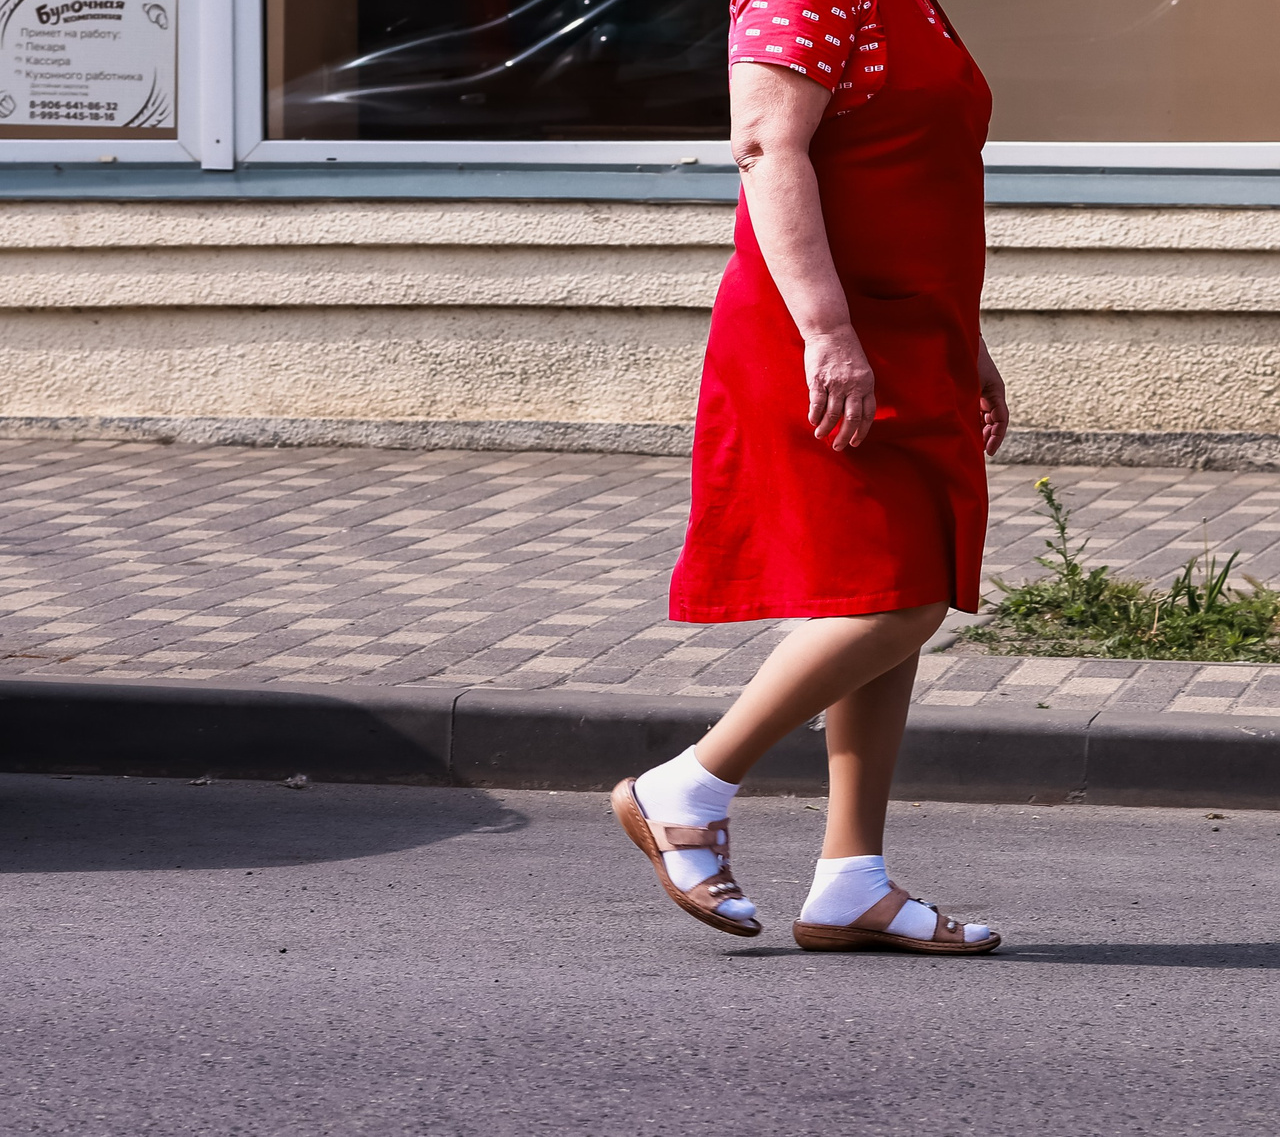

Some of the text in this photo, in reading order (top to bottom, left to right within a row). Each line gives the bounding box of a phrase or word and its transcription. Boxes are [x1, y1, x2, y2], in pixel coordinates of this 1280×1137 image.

[20, 28, 61, 39] Примет
[64, 30, 77, 38] на
[25, 41, 66, 52] Пекаря
[25, 56, 71, 67] Кассира
[85, 70, 143, 82] работника
